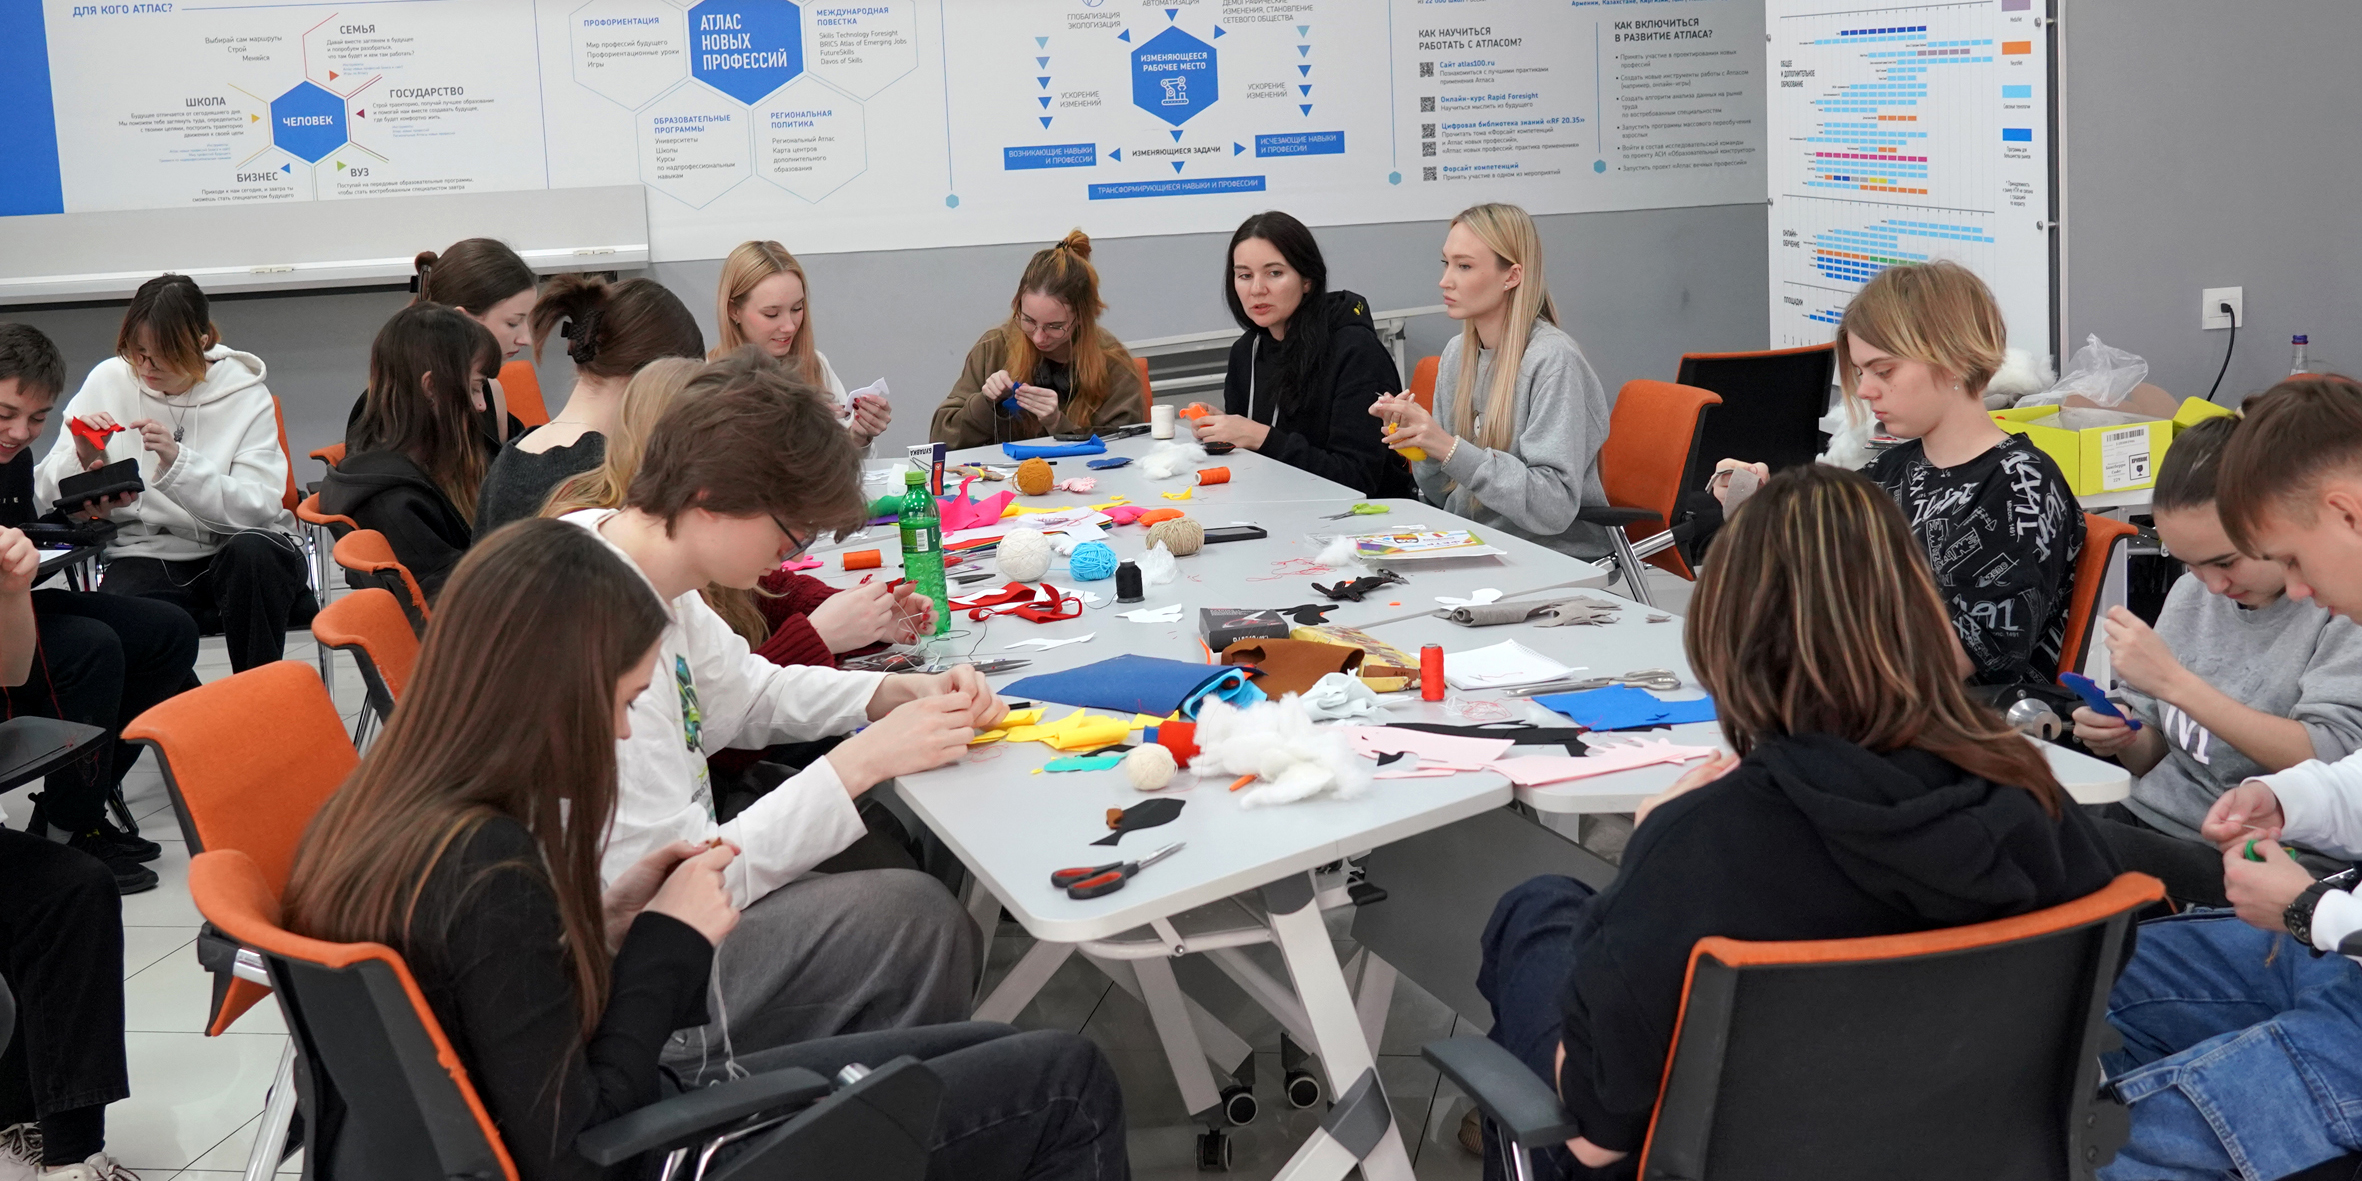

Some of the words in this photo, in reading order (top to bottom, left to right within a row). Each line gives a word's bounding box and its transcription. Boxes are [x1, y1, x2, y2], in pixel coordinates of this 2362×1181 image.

[73, 6, 97, 18] ДЛЯ
[101, 5, 129, 14] КОГО
[133, 4, 172, 13] АТЛАС?
[817, 7, 889, 16] МЕЖДУНАРОДНАЯ
[1266, 5, 1313, 13] СТАНОВЛЕНИЕ
[1067, 12, 1120, 20] ГЛОБАЛИЗАЦИЯ
[1223, 16, 1256, 24] СЕТЕВОГО
[584, 18, 659, 26] ПРОФОРИЕНТАЦИЯ
[701, 14, 741, 30] АТЛАС
[817, 18, 857, 26] ПОВЕСТКА
[1068, 21, 1121, 29] ЭКОЛОГИЗАЦИЯ
[1635, 18, 1699, 29] ВКЛЮЧИТЬСЯ
[340, 25, 375, 34] СЕМЬЯ
[1419, 30, 1436, 38] КАК
[1439, 27, 1491, 37] НАУЧИТЬСЯ
[1624, 32, 1670, 41] РАЗВИТИЕ
[1674, 30, 1712, 39] АТЛАСА?
[601, 40, 635, 48] профессий
[702, 34, 750, 50] НОВЫХ
[1419, 41, 1464, 50] РАБОТАТЬ
[1476, 38, 1522, 48] АТЛАСОМ?
[703, 49, 787, 70] ПРОФЕССИЙ
[1141, 53, 1207, 62] ИЗМЕНЯЮЩЕЕСЯ
[1180, 62, 1206, 70] МЕСТО
[1248, 82, 1285, 90] УСКОРЕНИЕ
[390, 87, 464, 98] ГОСУДАРСТВО
[1061, 91, 1099, 99] УСКОРЕНИЕ
[1247, 90, 1287, 99] ИЗМЕНЕНИЙ
[186, 97, 226, 107] ШКОЛА
[1060, 98, 1101, 107] ИЗМЕНЕНИЙ
[771, 110, 832, 119] РЕГИОНАЛЬНАЯ
[283, 116, 333, 126] ЧЕЛОВЕК
[654, 115, 730, 124] ОБРАЗОВАТЕЛЬНЫЕ
[772, 136, 816, 144] Региональный
[1260, 136, 1306, 144] ИСЧЕЗАЮЩИЕ
[1009, 149, 1062, 157] ВОЗНИКАЮЩИЕ
[1132, 148, 1191, 156] ИЗМЕНЯЮЩИЕСЯ
[1267, 145, 1307, 153] ПРОФЕССИИ
[1052, 156, 1093, 164] ПРОФЕССИИ
[666, 163, 735, 171] надпрофессиональным
[237, 172, 277, 182] БИЗНЕС
[351, 168, 369, 177] ВУЗ
[1098, 184, 1181, 193] ТРАНСФОРМИРУЮЩИЕСЯ
[910, 447, 932, 456] БУЛАВКА
